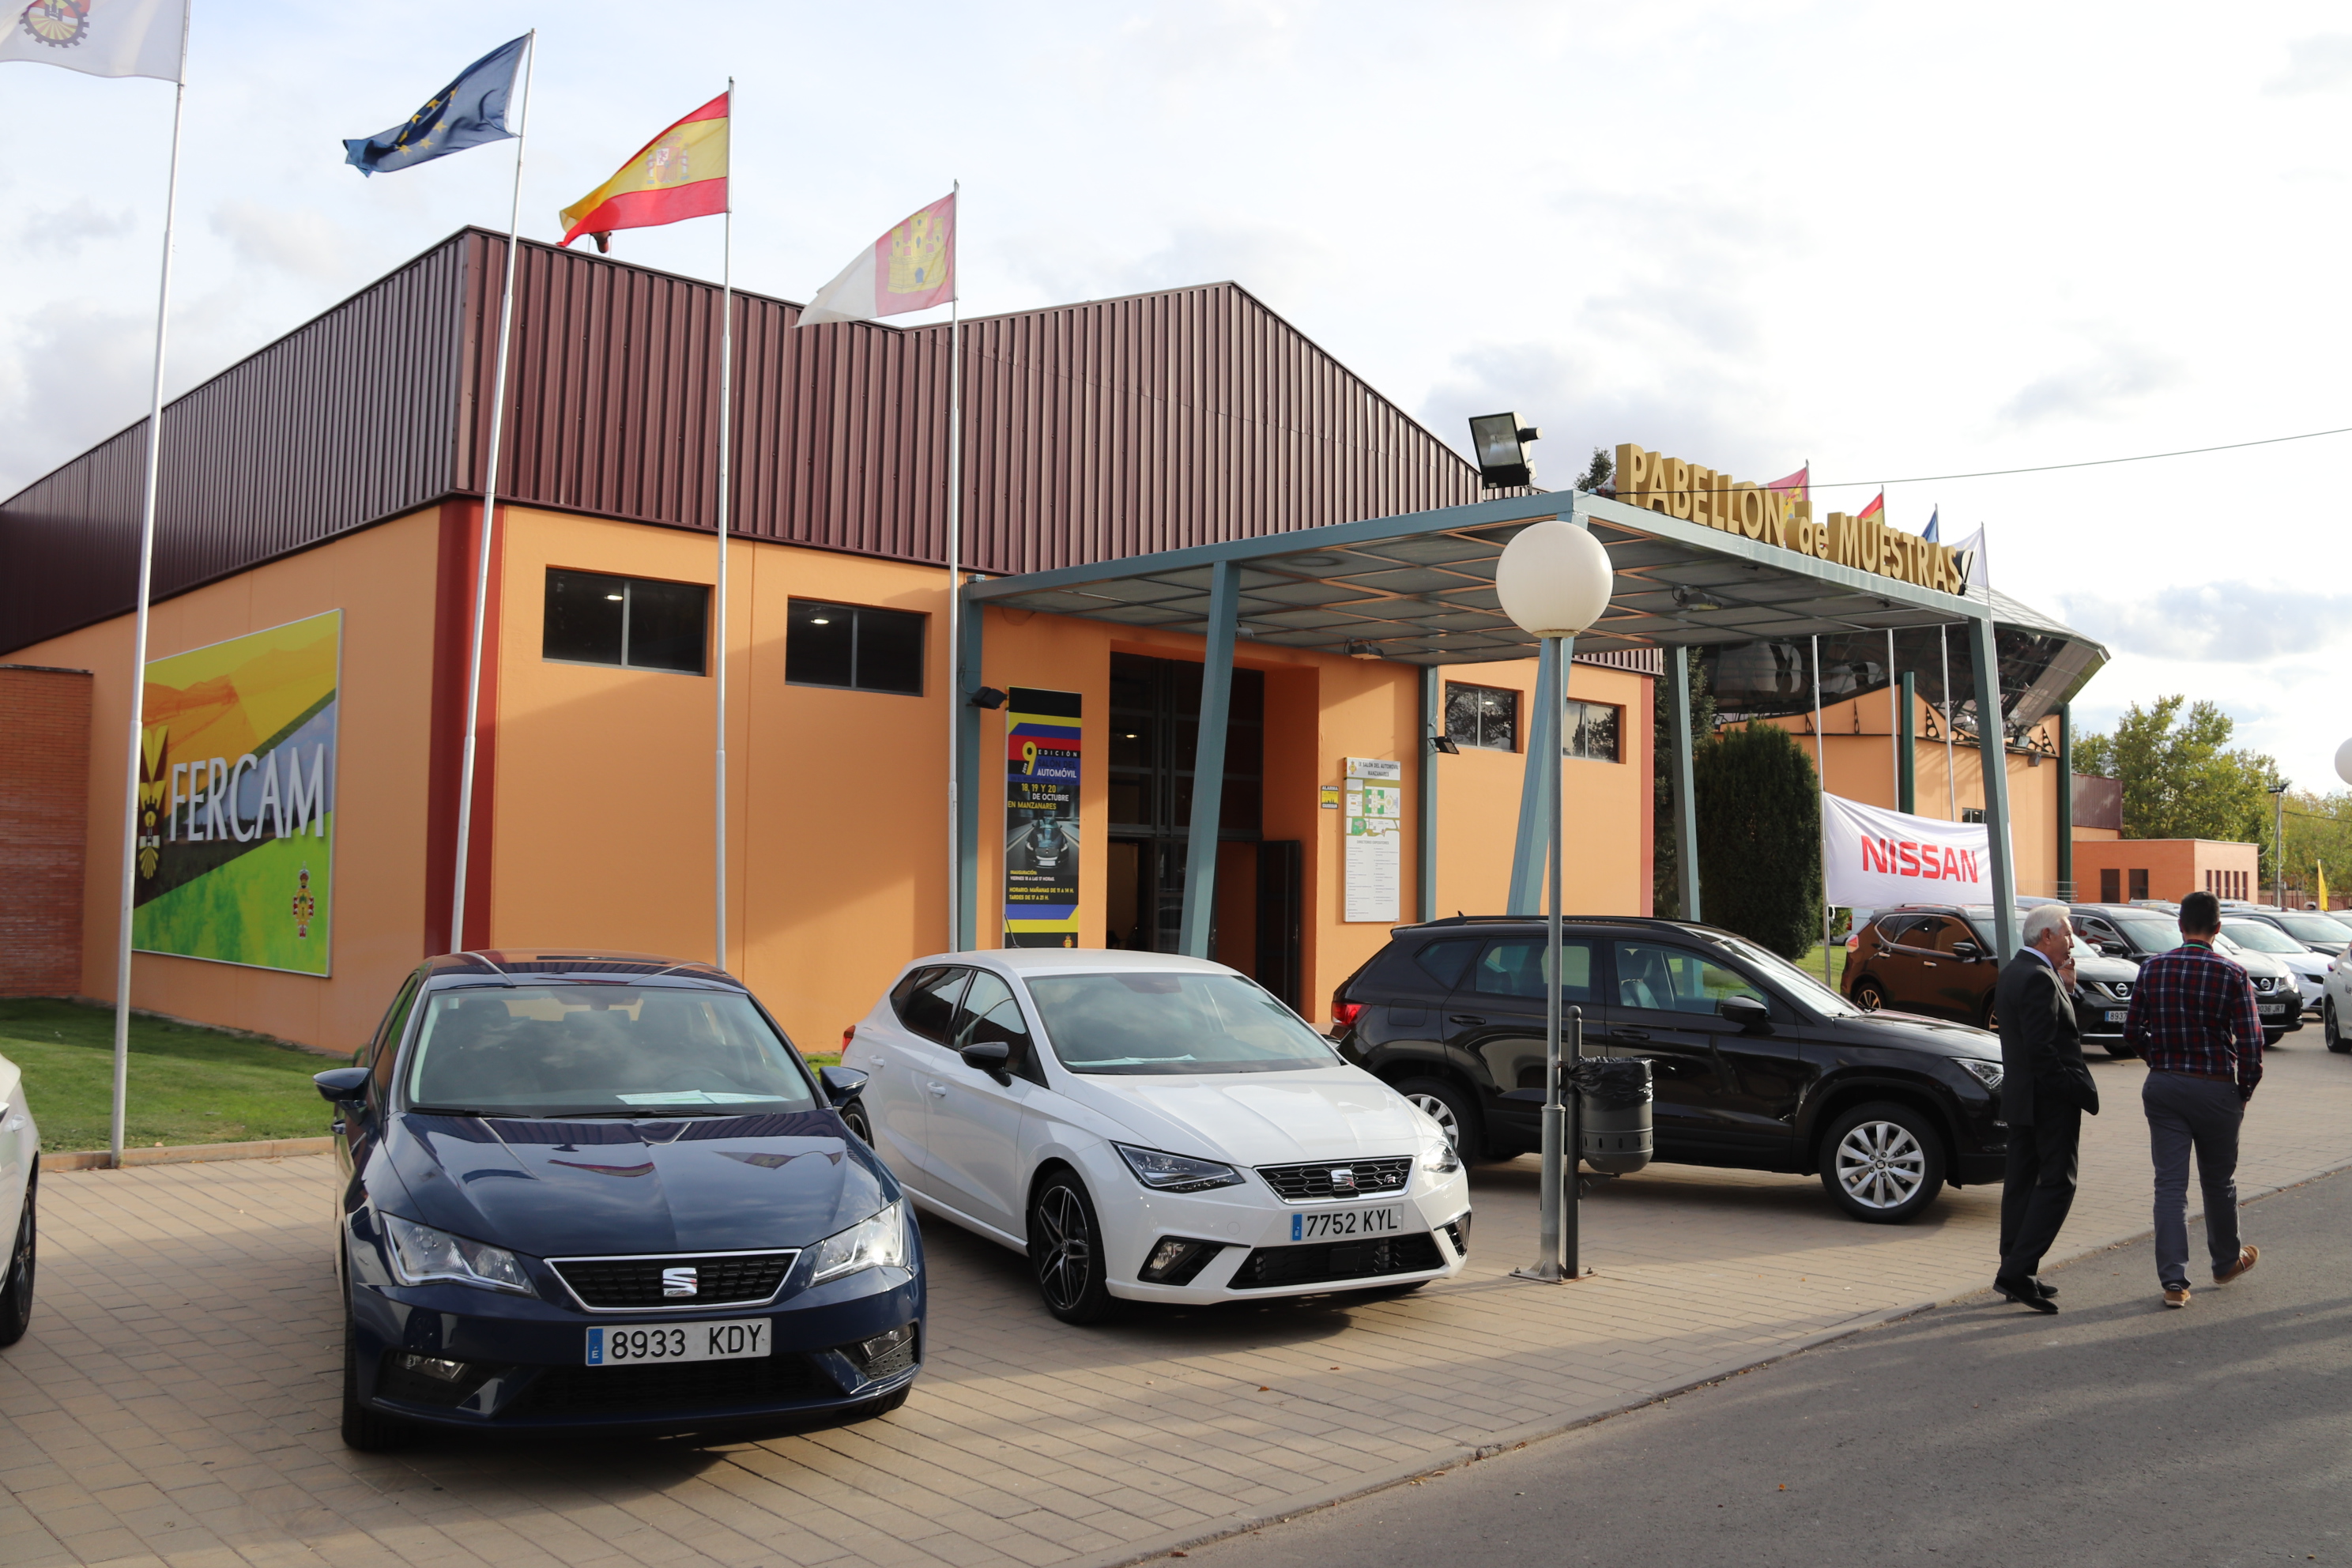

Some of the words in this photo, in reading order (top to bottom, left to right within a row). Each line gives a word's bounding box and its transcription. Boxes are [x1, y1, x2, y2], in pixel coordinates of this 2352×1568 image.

[1616, 443, 1785, 548] PABELLON
[1786, 500, 1829, 559] de
[1827, 511, 1960, 595] MUESTRAS
[1022, 741, 1037, 775] 9
[1037, 767, 1077, 778] AUTOMÓVIL
[1038, 759, 1061, 768] SALÓN
[1063, 760, 1076, 769] DEL
[169, 743, 324, 842] FERCAM
[1031, 783, 1038, 792] 19
[1861, 835, 1978, 884] NISSAN
[2110, 1012, 2127, 1020] 8937
[1306, 1212, 1356, 1238] 7752
[1363, 1208, 1397, 1233] KYL
[592, 1350, 599, 1359] E
[611, 1329, 686, 1359] 8933
[708, 1323, 763, 1355] KDY
